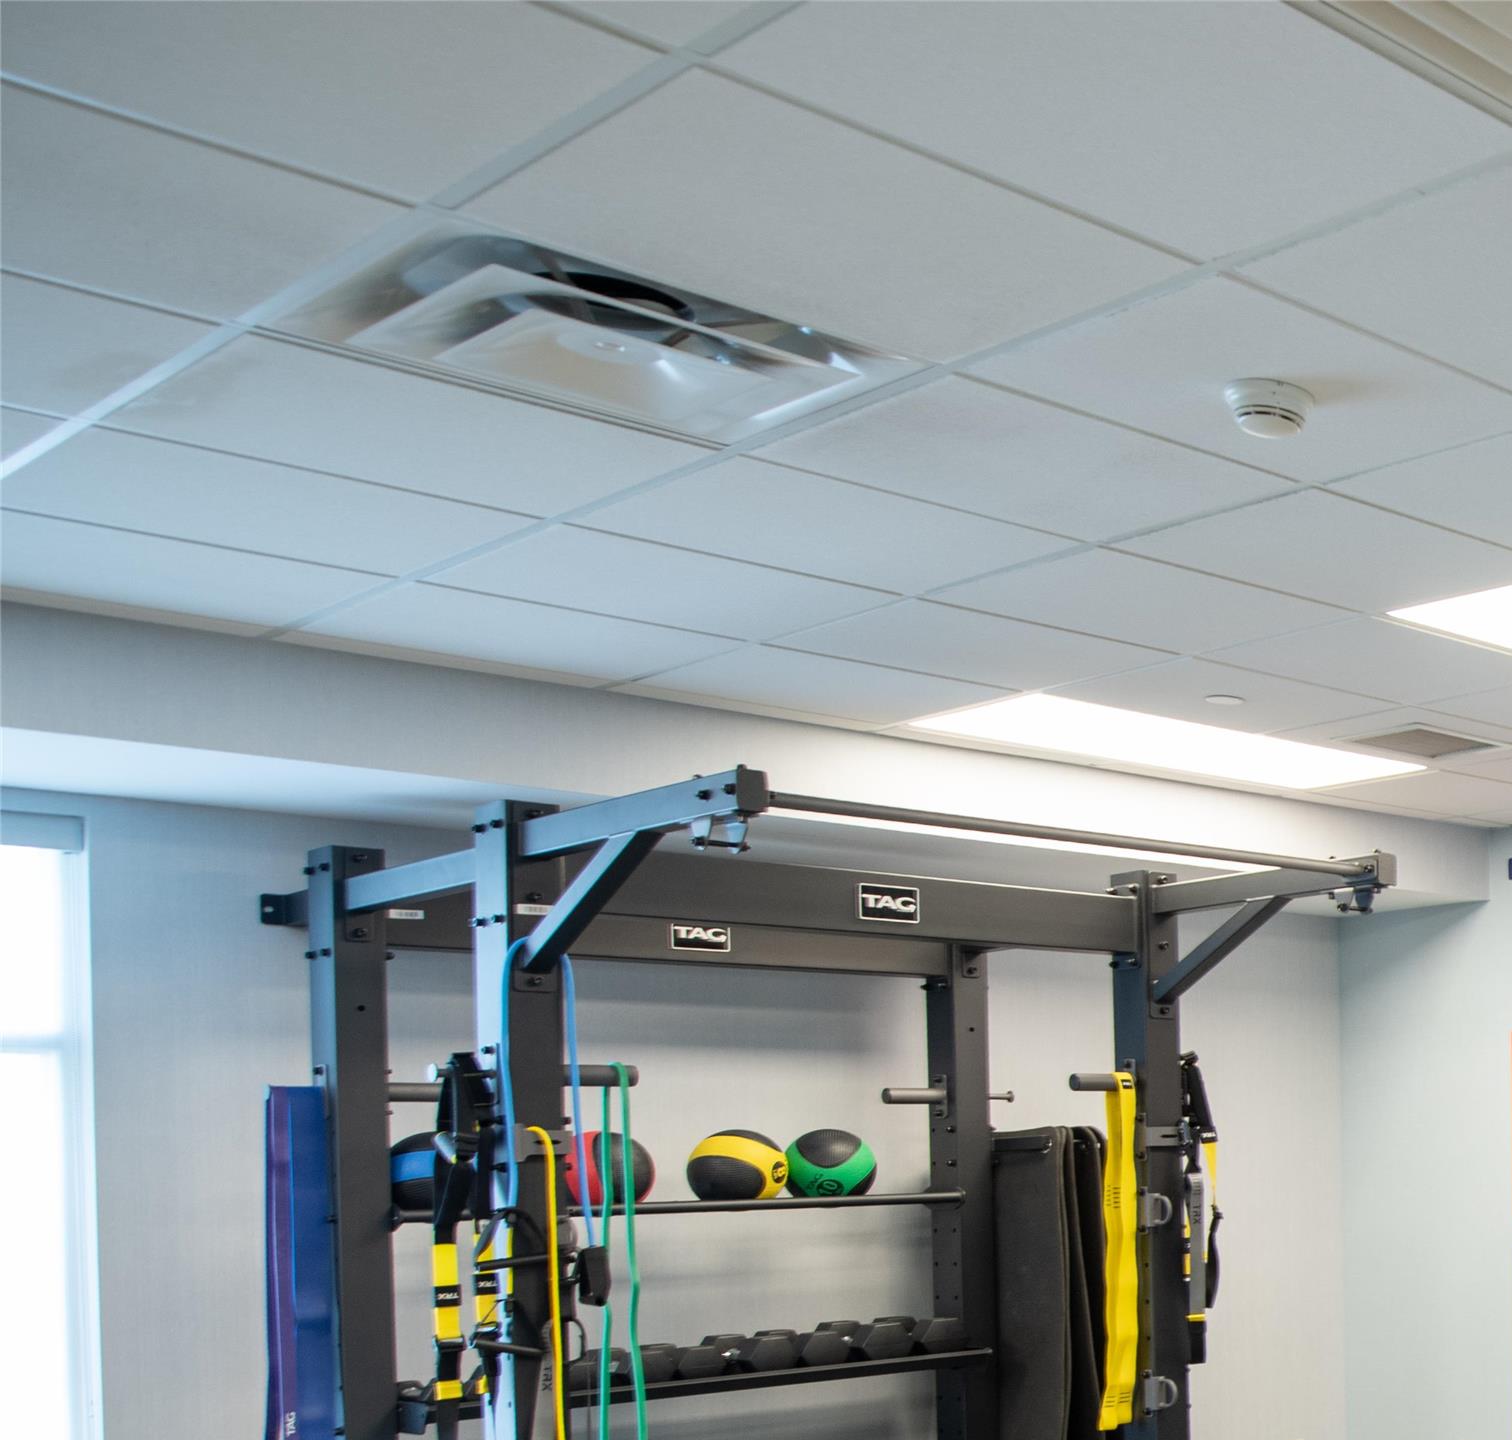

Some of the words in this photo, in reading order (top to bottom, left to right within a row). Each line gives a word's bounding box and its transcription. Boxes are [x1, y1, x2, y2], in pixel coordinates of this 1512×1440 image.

[861, 893, 917, 913] TAG
[674, 925, 728, 943] TAG
[285, 1411, 297, 1438] TAG
